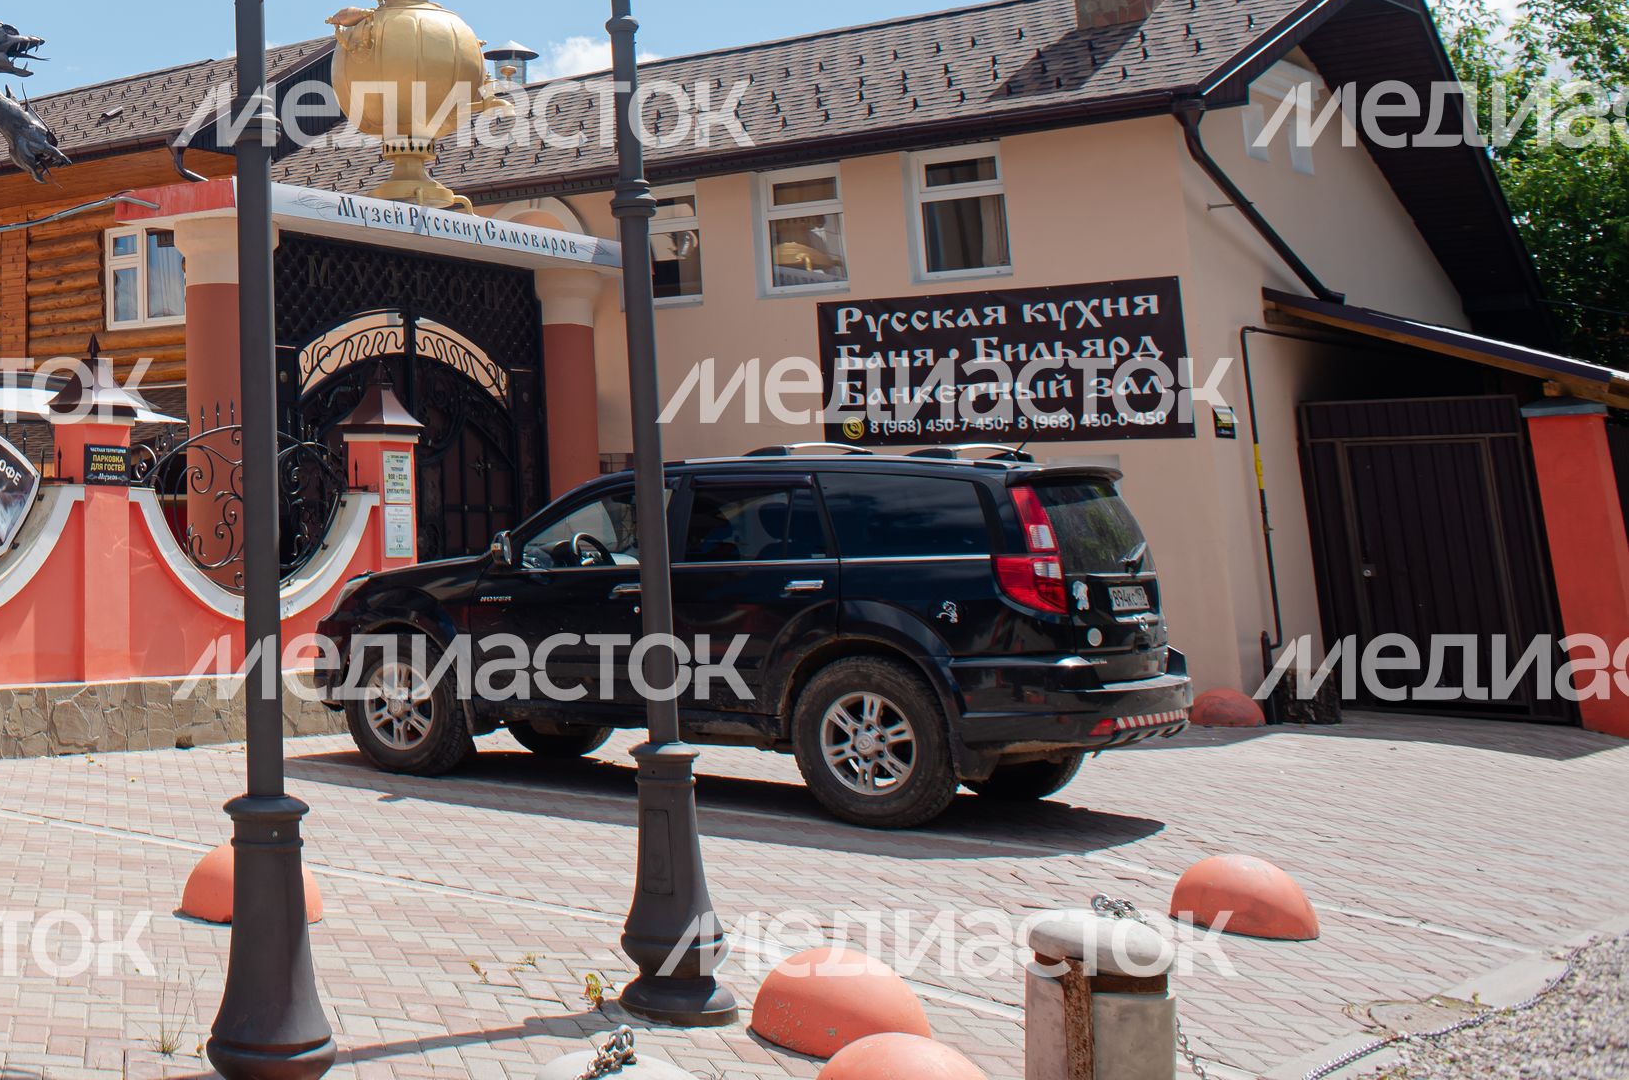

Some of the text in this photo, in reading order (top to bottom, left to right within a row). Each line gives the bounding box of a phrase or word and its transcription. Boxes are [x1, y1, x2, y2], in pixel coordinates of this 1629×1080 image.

[337, 195, 577, 256] Музей Русских Самоваров
[834, 294, 1159, 342] Русская кухня
[836, 335, 1164, 370] Баня Бильярд
[837, 373, 1167, 406] Банкетный зал
[869, 421, 879, 434] 8
[882, 419, 922, 436] (968)
[1018, 416, 1028, 430] 8
[1032, 413, 1076, 432] (968)
[1079, 410, 1167, 428] 450-0-450
[90, 462, 126, 472] ДЛЯ ГОСТЕЙ
[92, 454, 124, 463] ПАРКОВКА
